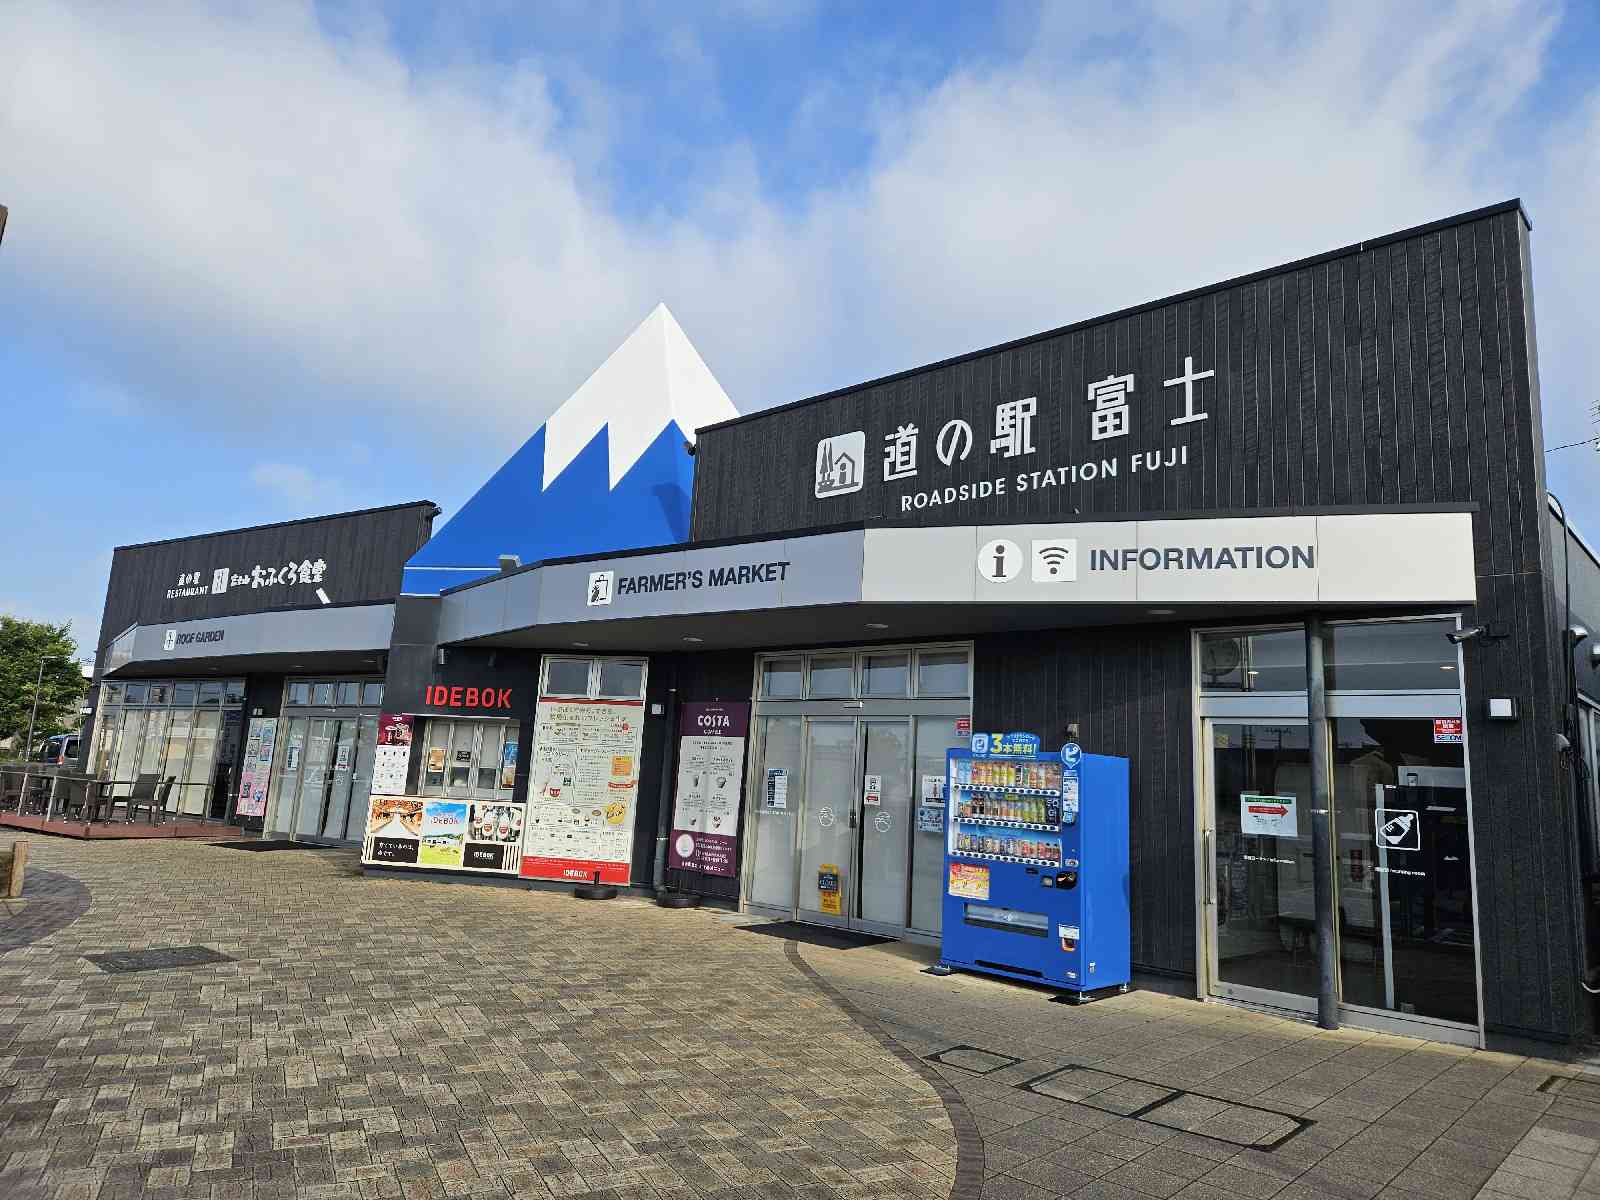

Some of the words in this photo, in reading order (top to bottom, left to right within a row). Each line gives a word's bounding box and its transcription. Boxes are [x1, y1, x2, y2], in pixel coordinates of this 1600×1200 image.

[883, 396, 1038, 482] 道の駅
[1087, 356, 1215, 441] 富士
[900, 477, 1006, 512] ROADSIDE
[1016, 458, 1118, 493] STATION
[1131, 445, 1188, 474] FUJI
[1090, 544, 1315, 571] INFORMATION
[617, 568, 703, 595] FARMER'S
[708, 561, 791, 587] MARKET
[166, 585, 209, 599] RESTAURANT
[176, 631, 196, 645] ROOF
[195, 629, 225, 643] GARDEN
[425, 685, 513, 709] IDEBOK
[697, 714, 730, 728] COSTA
